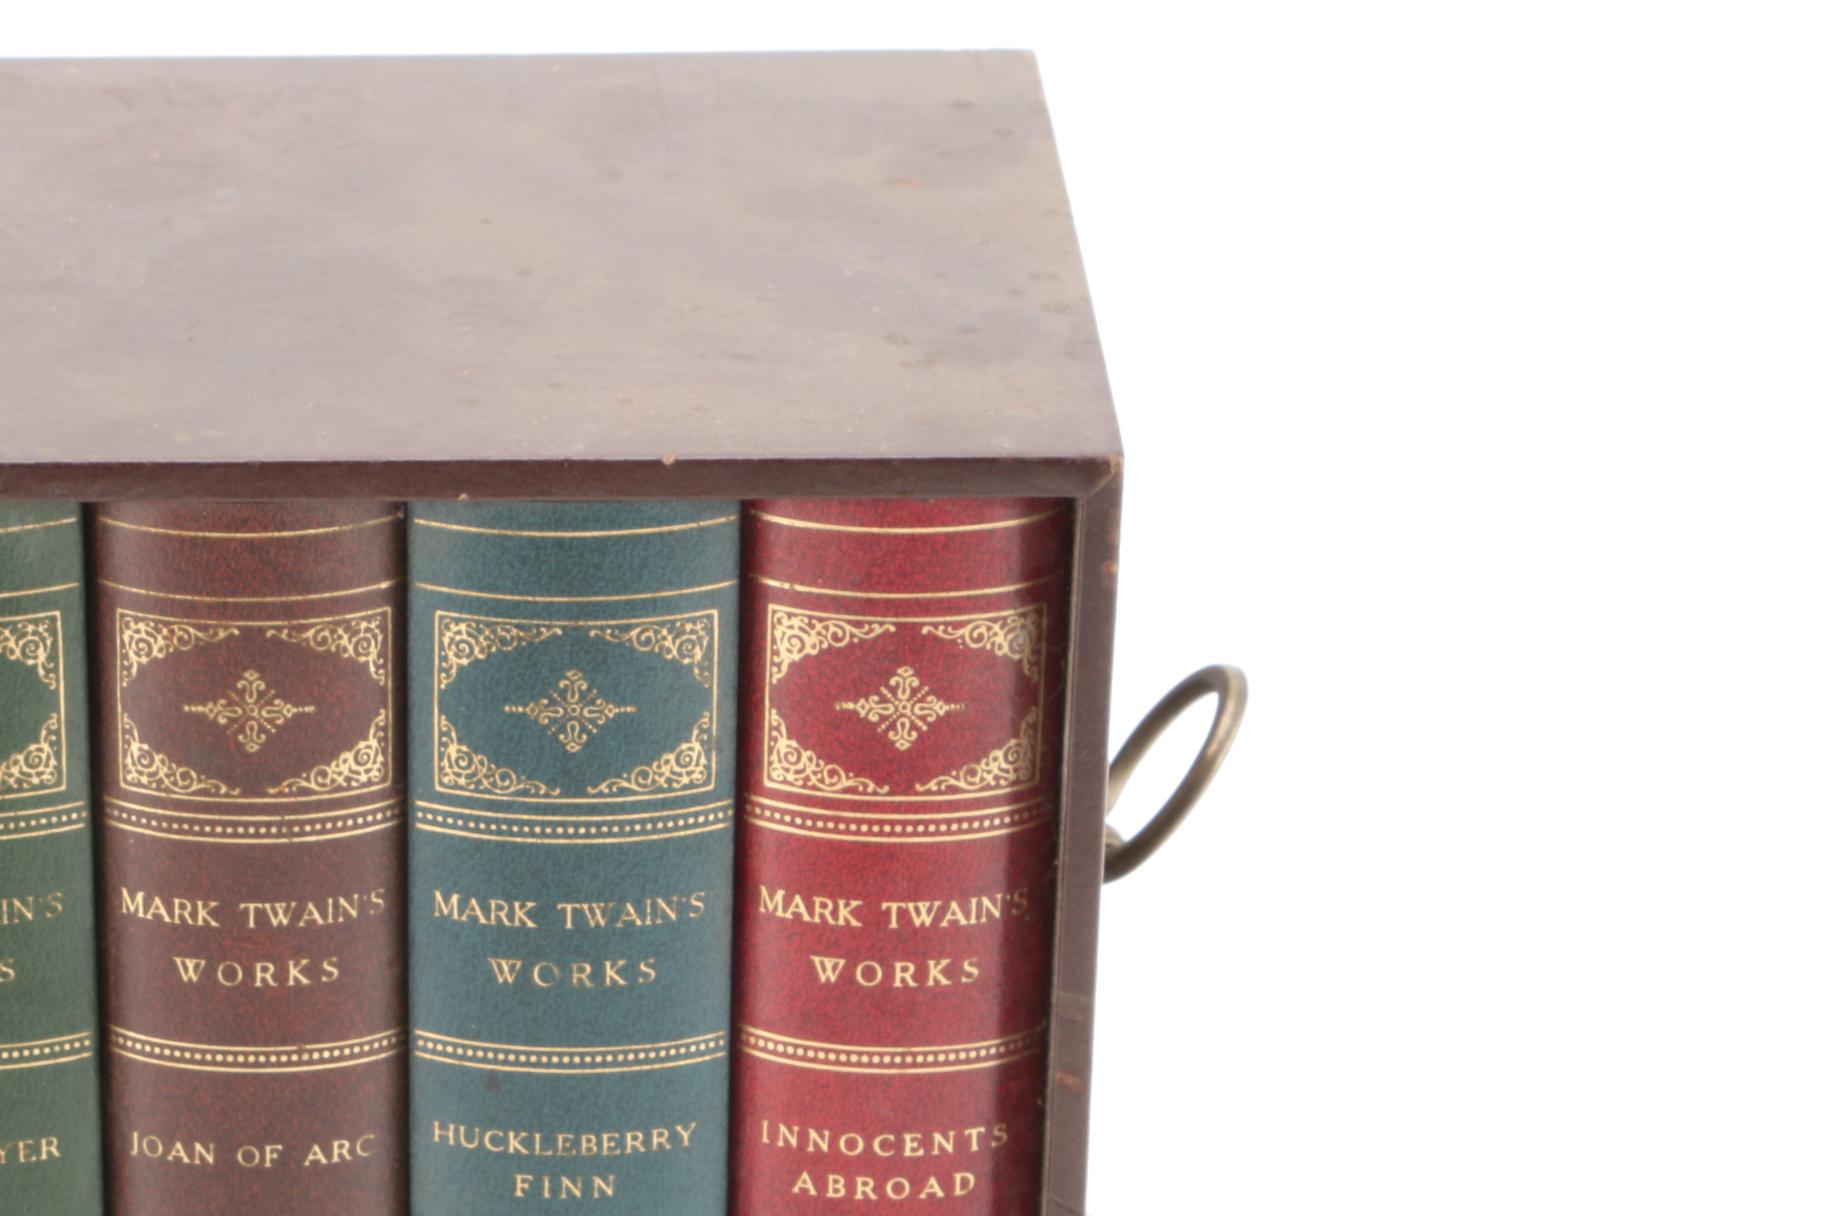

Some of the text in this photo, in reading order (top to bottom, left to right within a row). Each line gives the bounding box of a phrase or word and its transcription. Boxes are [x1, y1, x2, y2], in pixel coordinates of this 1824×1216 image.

[121, 888, 385, 928] MARK TWAIN'S
[433, 890, 707, 929] MARK TWAIN'S
[758, 886, 1029, 928] MARK TWAIN'S
[173, 957, 340, 988] WORKS
[488, 958, 657, 988] WORKS
[810, 955, 980, 988] WORKS
[130, 1131, 375, 1168] JOAN OF ARC
[433, 1121, 697, 1156] HUCKLEBERRY
[761, 1120, 1007, 1157] INNOCENTS
[514, 1174, 616, 1198] FINN
[792, 1171, 975, 1200] ABROAD
